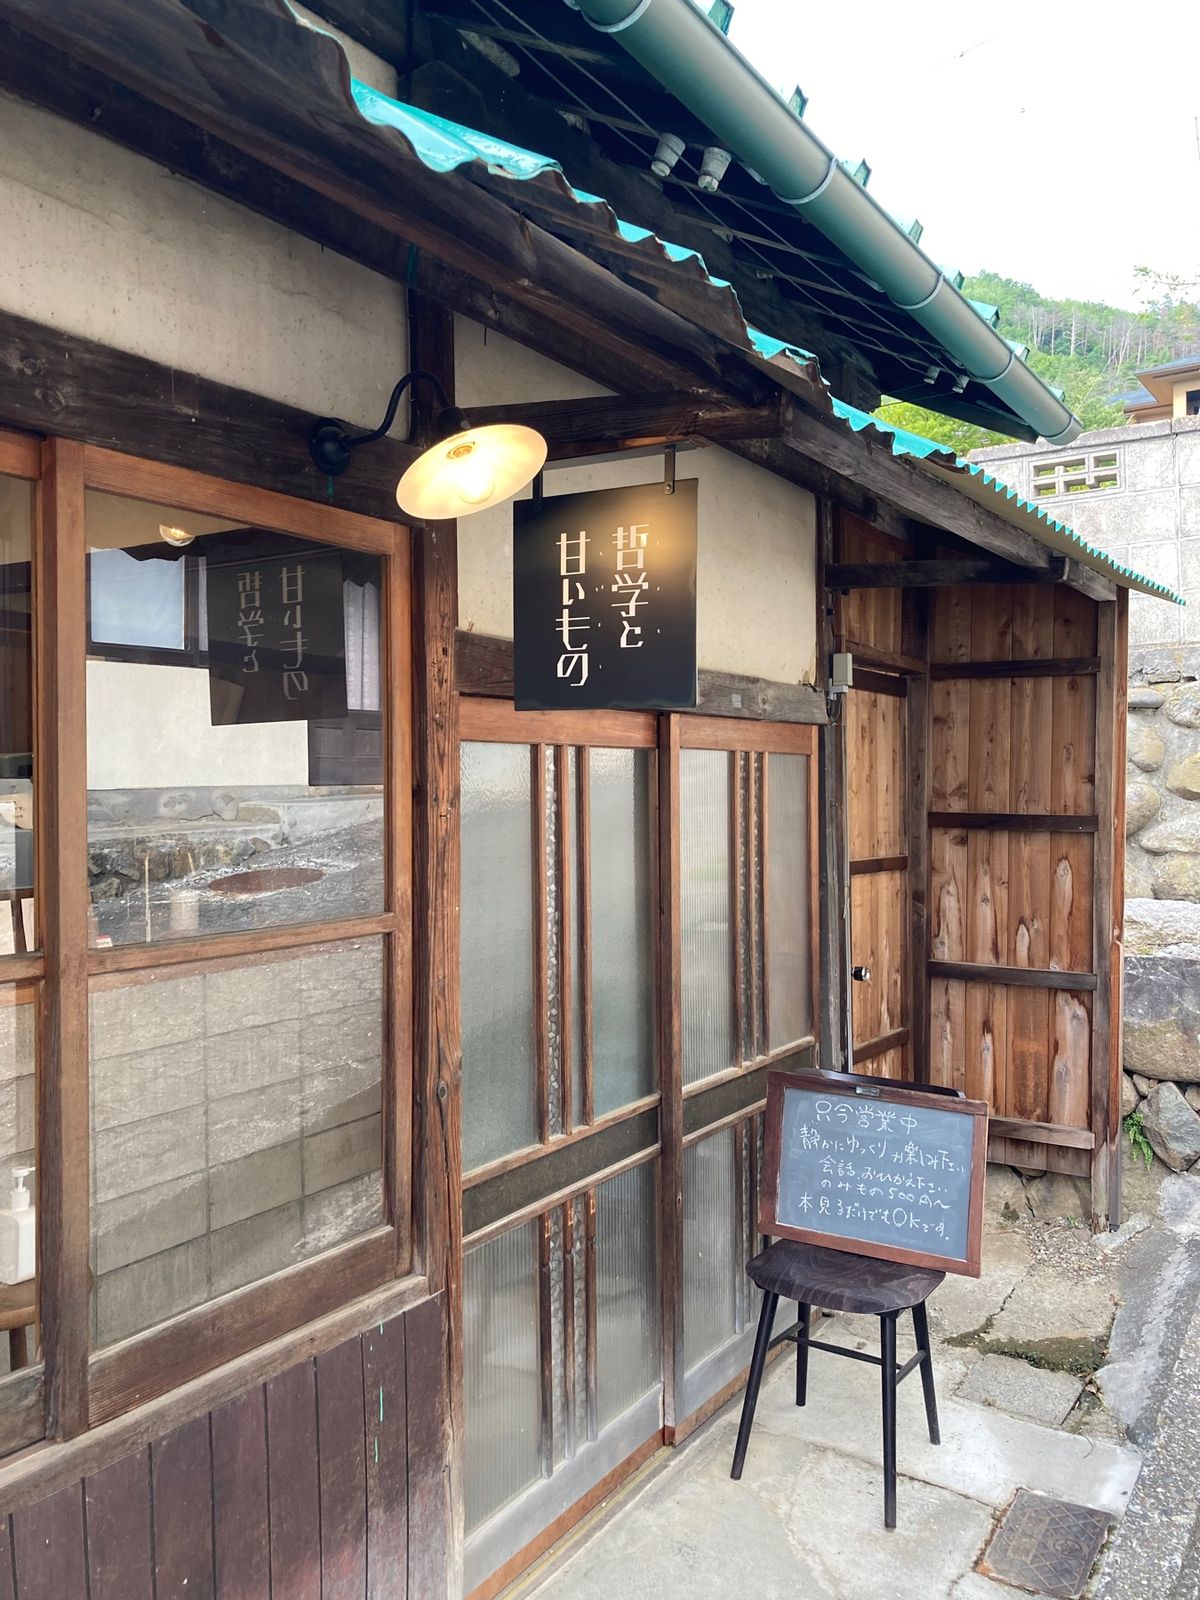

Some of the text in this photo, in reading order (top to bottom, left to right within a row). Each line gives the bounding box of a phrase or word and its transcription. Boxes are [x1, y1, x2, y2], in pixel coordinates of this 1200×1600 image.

[555, 530, 591, 687] 甘いもの
[611, 523, 649, 648] 哲学と
[815, 1100, 918, 1135] 只今営業中
